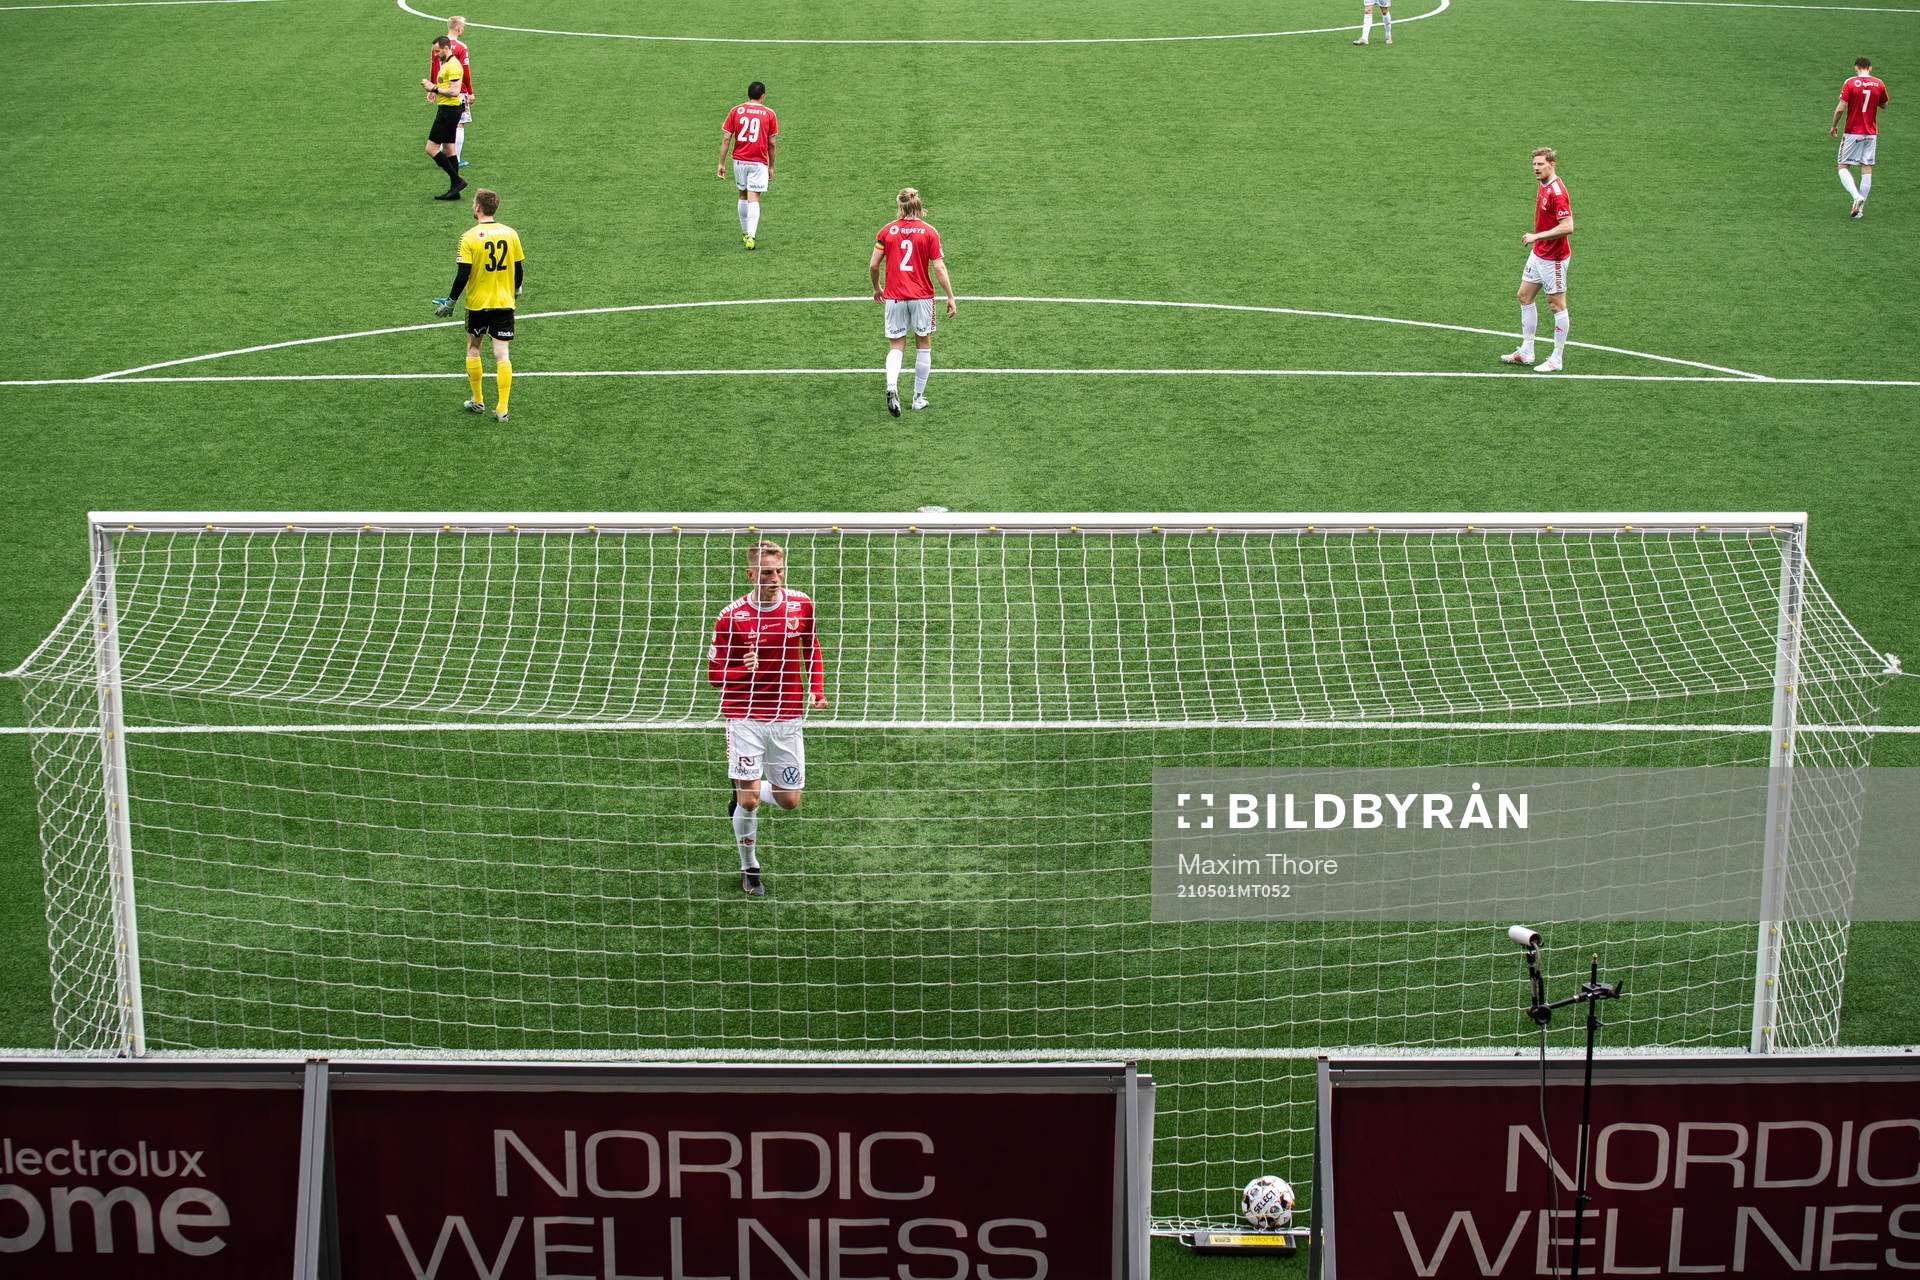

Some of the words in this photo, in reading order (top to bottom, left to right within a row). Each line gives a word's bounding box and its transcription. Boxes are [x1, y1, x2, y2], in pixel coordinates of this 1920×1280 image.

[1861, 89, 1872, 113] 7
[737, 116, 761, 143] 29
[484, 239, 508, 272] 32
[899, 239, 914, 272] 2
[0, 1138, 207, 1178] lectrolux
[493, 1128, 937, 1200] NORDIC
[1505, 1118, 1920, 1193] NORDIC
[1253, 1190, 1276, 1214] SELECT
[386, 1214, 1050, 1280] WELLNESS
